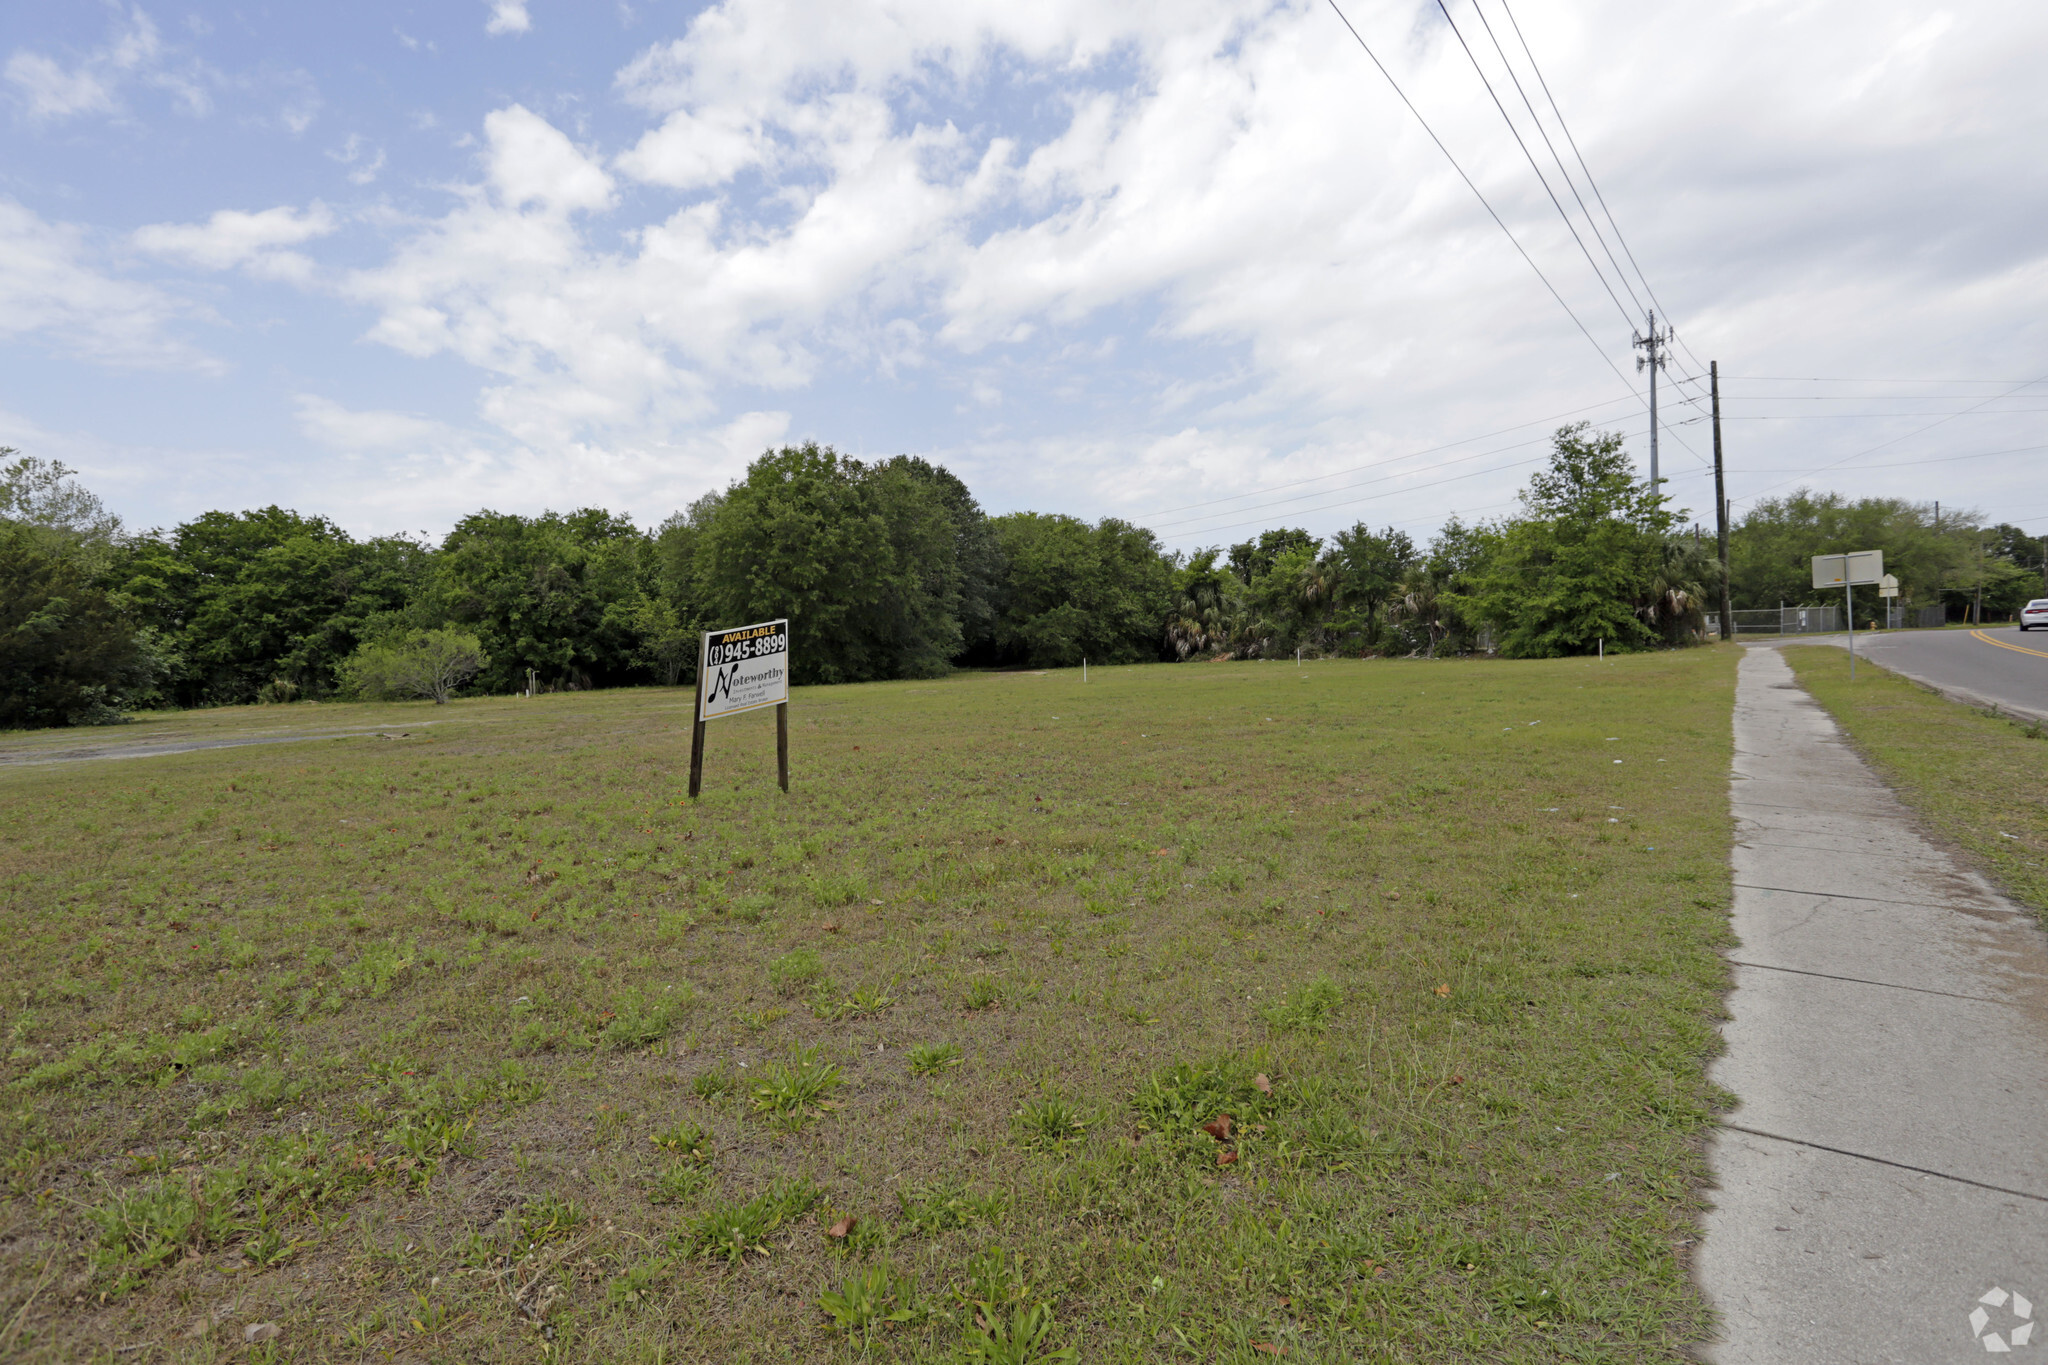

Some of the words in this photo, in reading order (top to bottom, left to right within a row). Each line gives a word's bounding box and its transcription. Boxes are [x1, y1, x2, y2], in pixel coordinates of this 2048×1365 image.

[722, 626, 776, 643] AVAILABLE
[725, 633, 785, 662] 945-8899
[708, 663, 785, 704] Noteworthy
[729, 695, 742, 704] Mary
